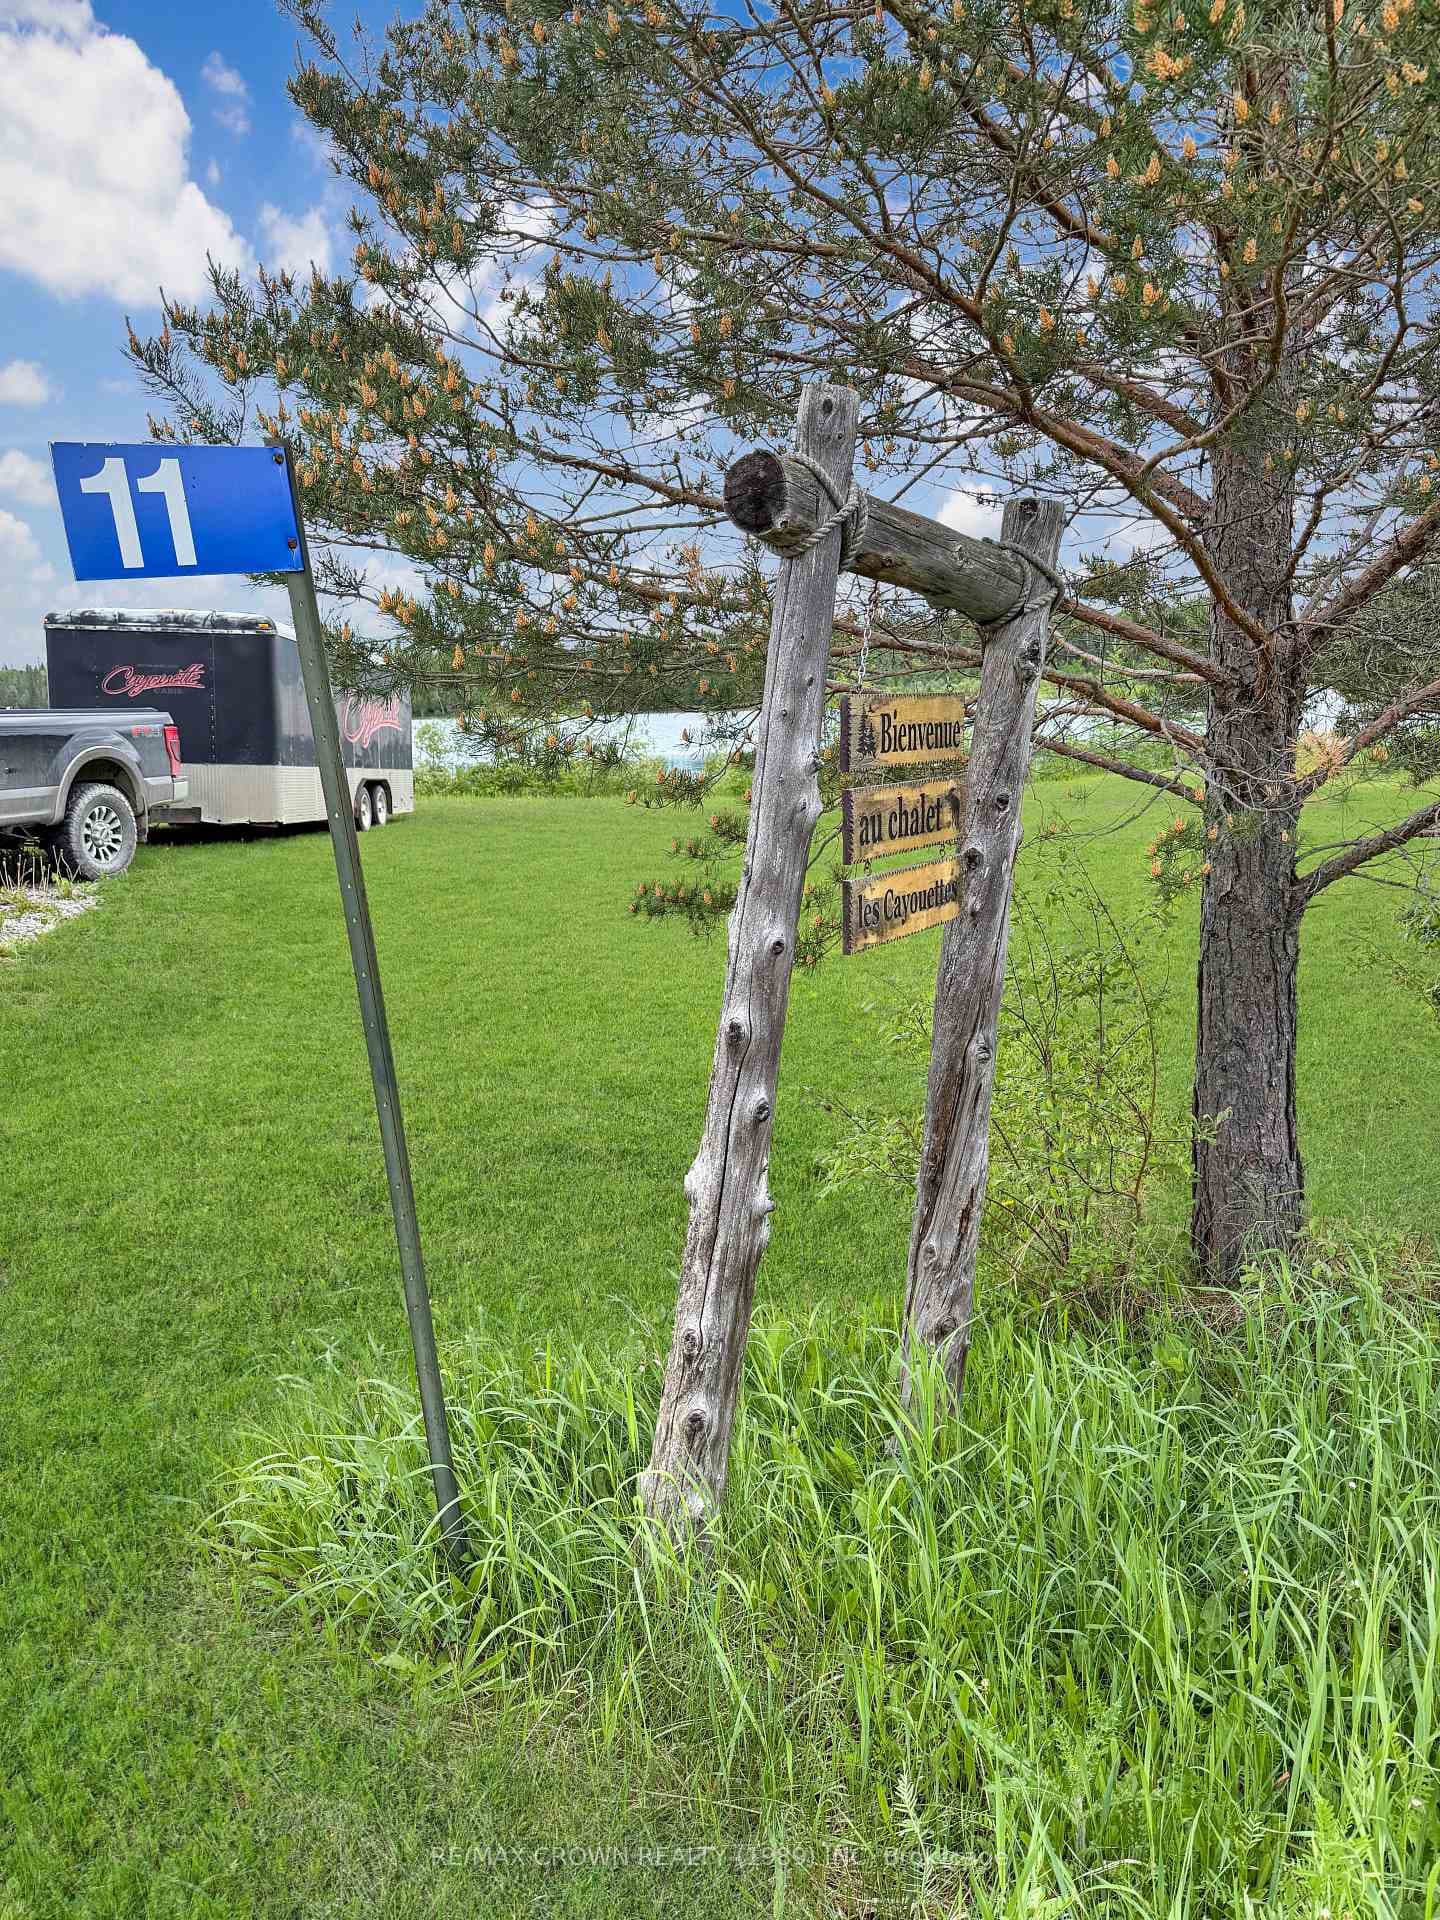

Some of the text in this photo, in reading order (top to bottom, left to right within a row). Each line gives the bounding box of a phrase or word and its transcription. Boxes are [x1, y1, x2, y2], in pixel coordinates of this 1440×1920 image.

[80, 457, 197, 568] 11
[880, 709, 960, 753] Bienvenue
[860, 793, 942, 846] au chalet
[858, 894, 880, 928] les
